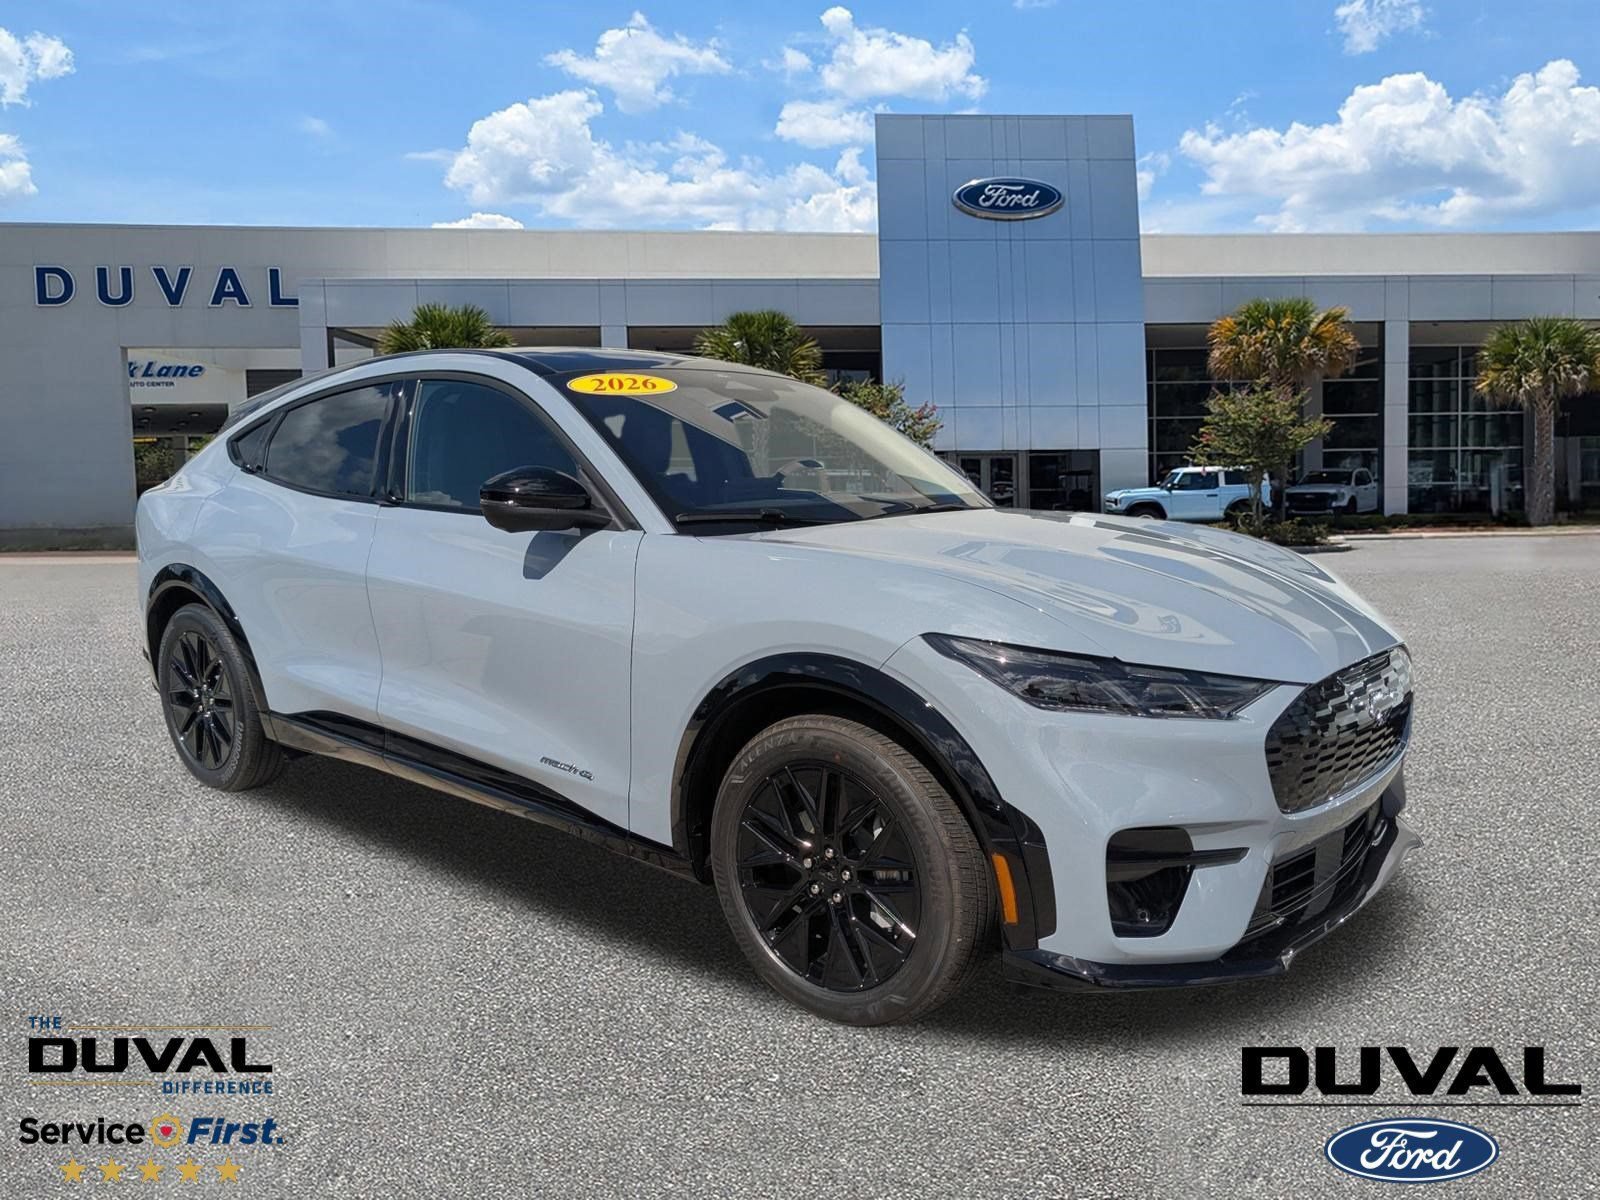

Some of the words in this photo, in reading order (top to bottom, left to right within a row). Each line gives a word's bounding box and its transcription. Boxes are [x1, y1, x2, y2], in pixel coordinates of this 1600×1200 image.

[978, 184, 1040, 207] Ford
[33, 265, 299, 308] DUVAL
[141, 361, 205, 378] Lane
[590, 377, 658, 392] 2026
